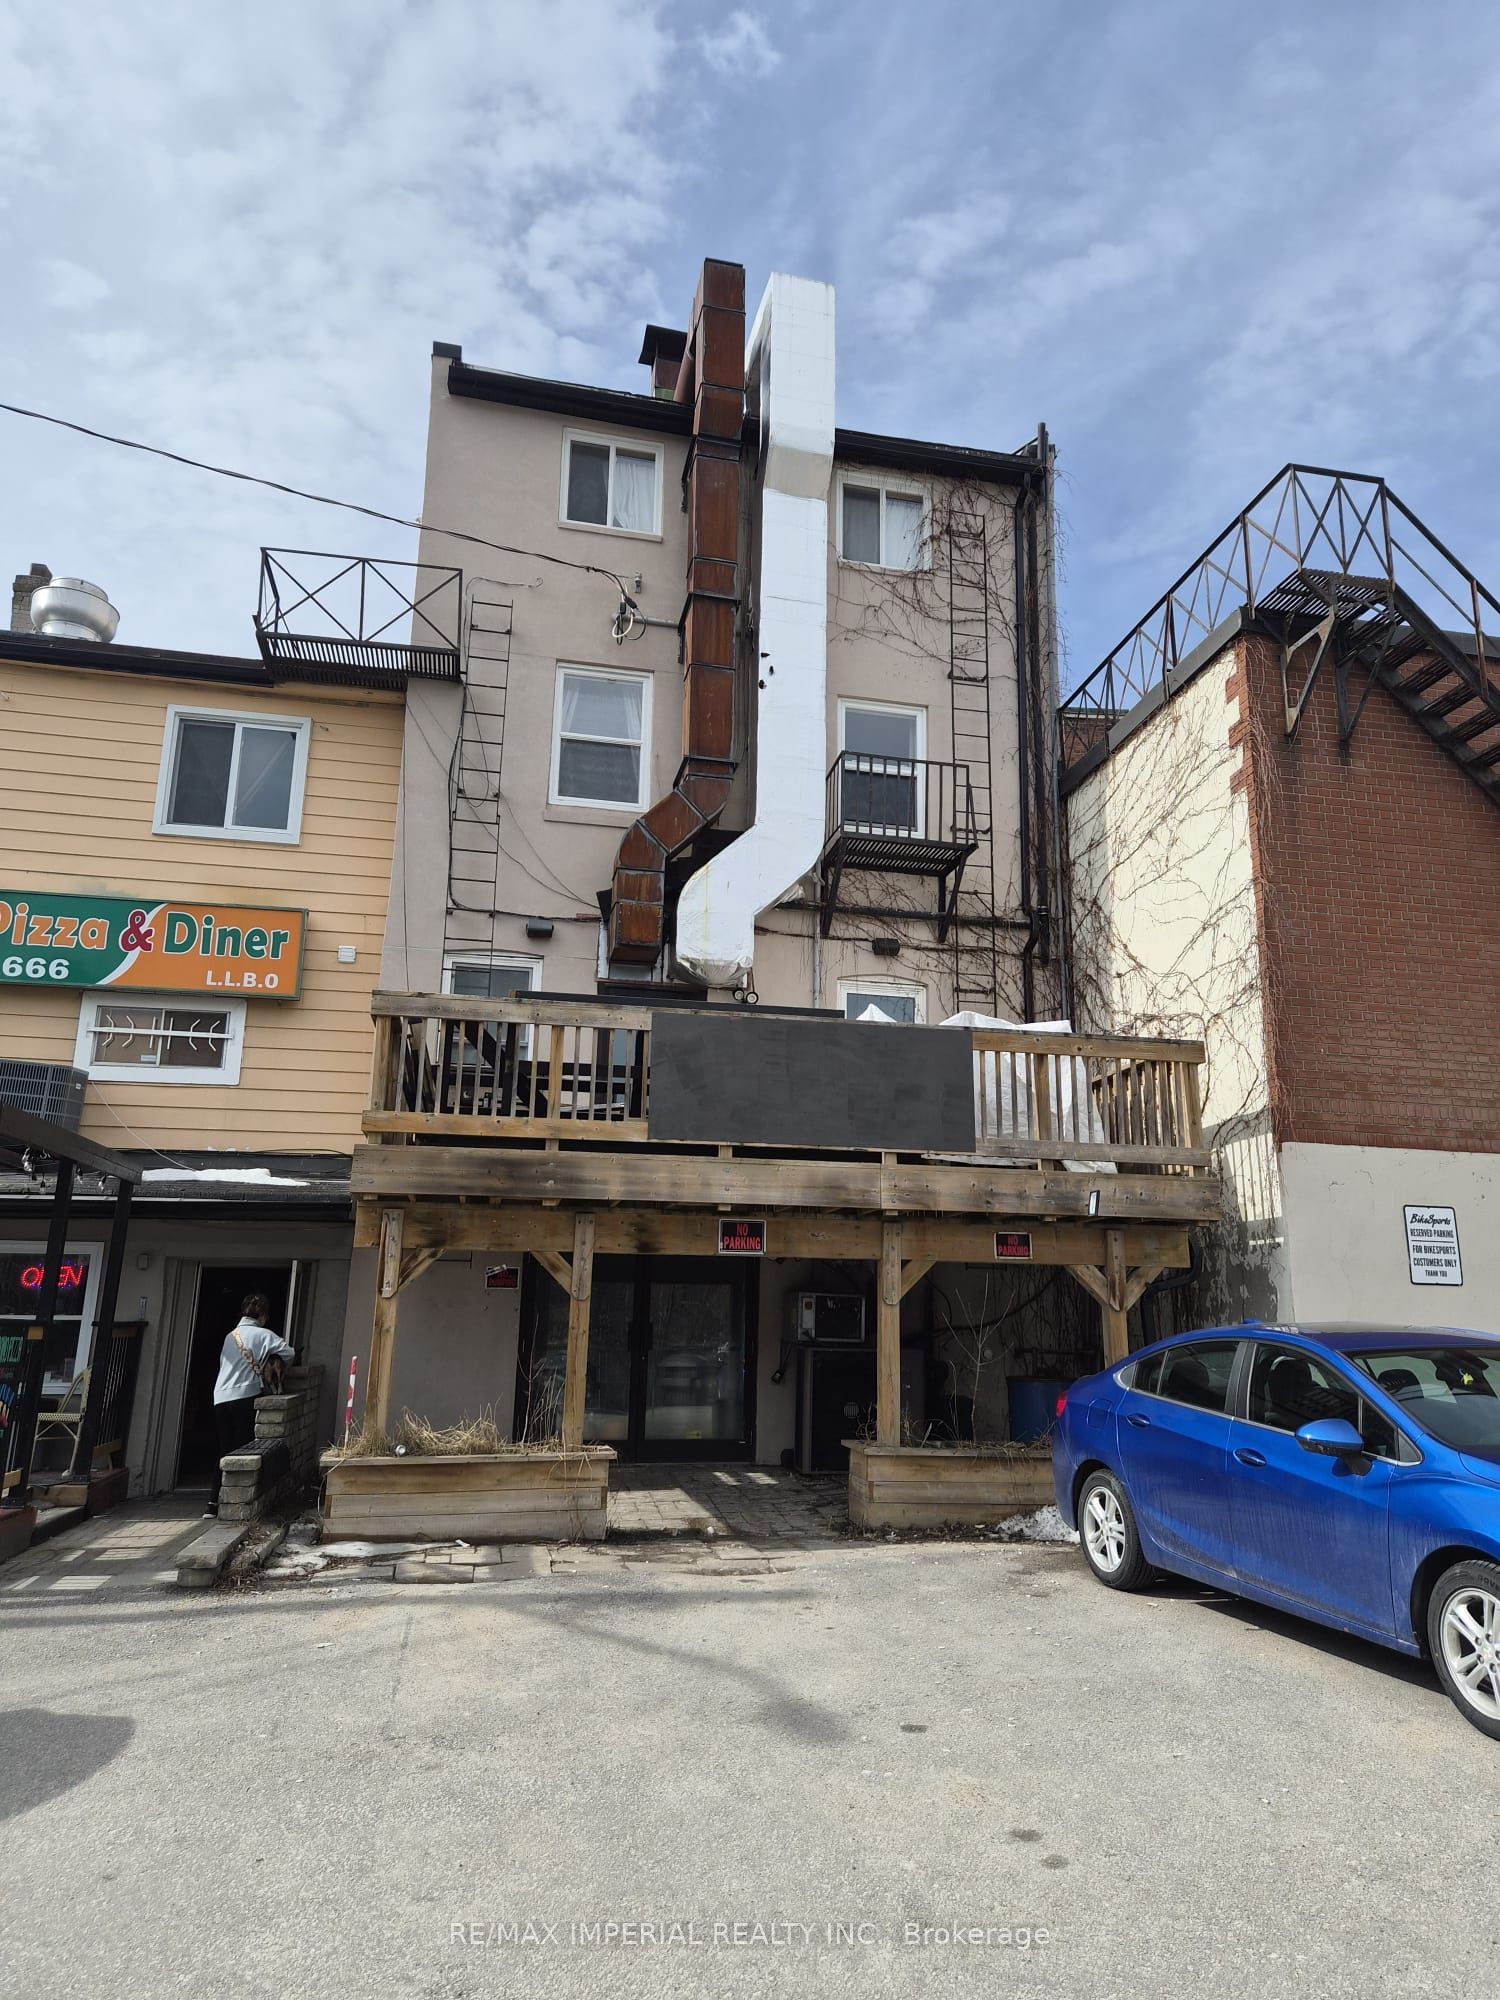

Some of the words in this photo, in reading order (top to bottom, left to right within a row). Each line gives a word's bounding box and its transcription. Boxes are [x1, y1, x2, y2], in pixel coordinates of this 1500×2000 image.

[119, 909, 155, 952] &
[163, 911, 289, 959] Diner
[736, 1223, 749, 1236] NO
[1410, 1228, 1433, 1238] RESERVED
[1433, 1229, 1454, 1238] PARKING
[723, 1236, 761, 1249] PARKING
[1412, 1244, 1423, 1254] FOR
[1424, 1245, 1456, 1255] BIKESPORTS
[1413, 1257, 1443, 1267] CUSTOMERS
[1444, 1258, 1457, 1268] ONLY
[1425, 1269, 1438, 1277] THANK
